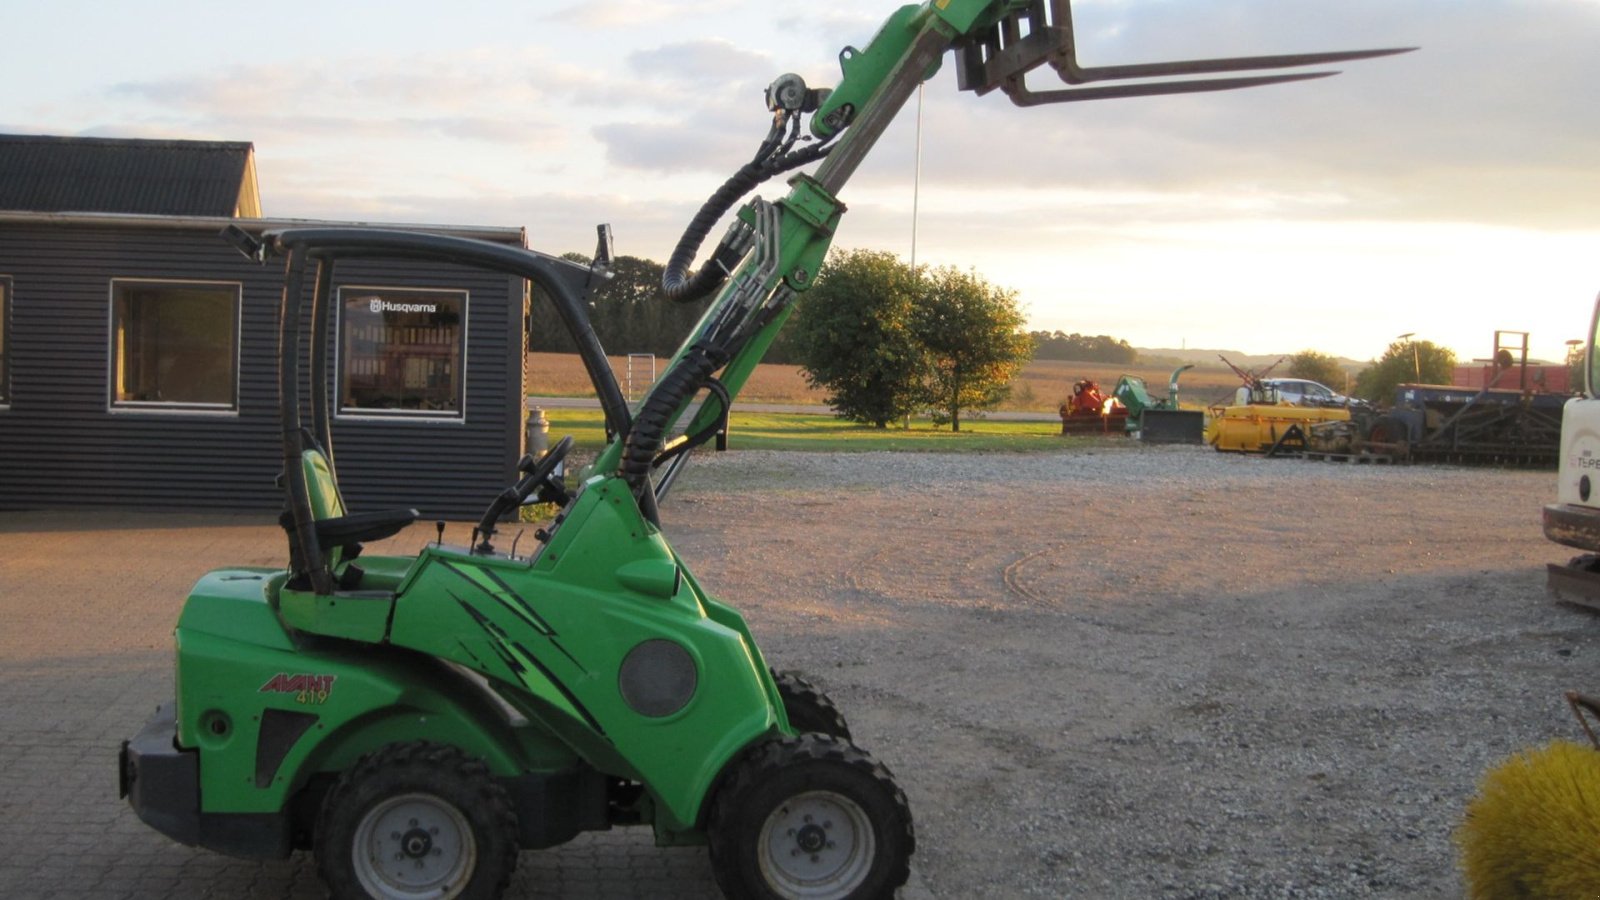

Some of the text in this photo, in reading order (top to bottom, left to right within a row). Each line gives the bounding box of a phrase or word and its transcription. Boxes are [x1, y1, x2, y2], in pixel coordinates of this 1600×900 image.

[382, 301, 437, 313] Husqvarna
[257, 672, 337, 696] AVANT
[296, 689, 327, 704] 419
